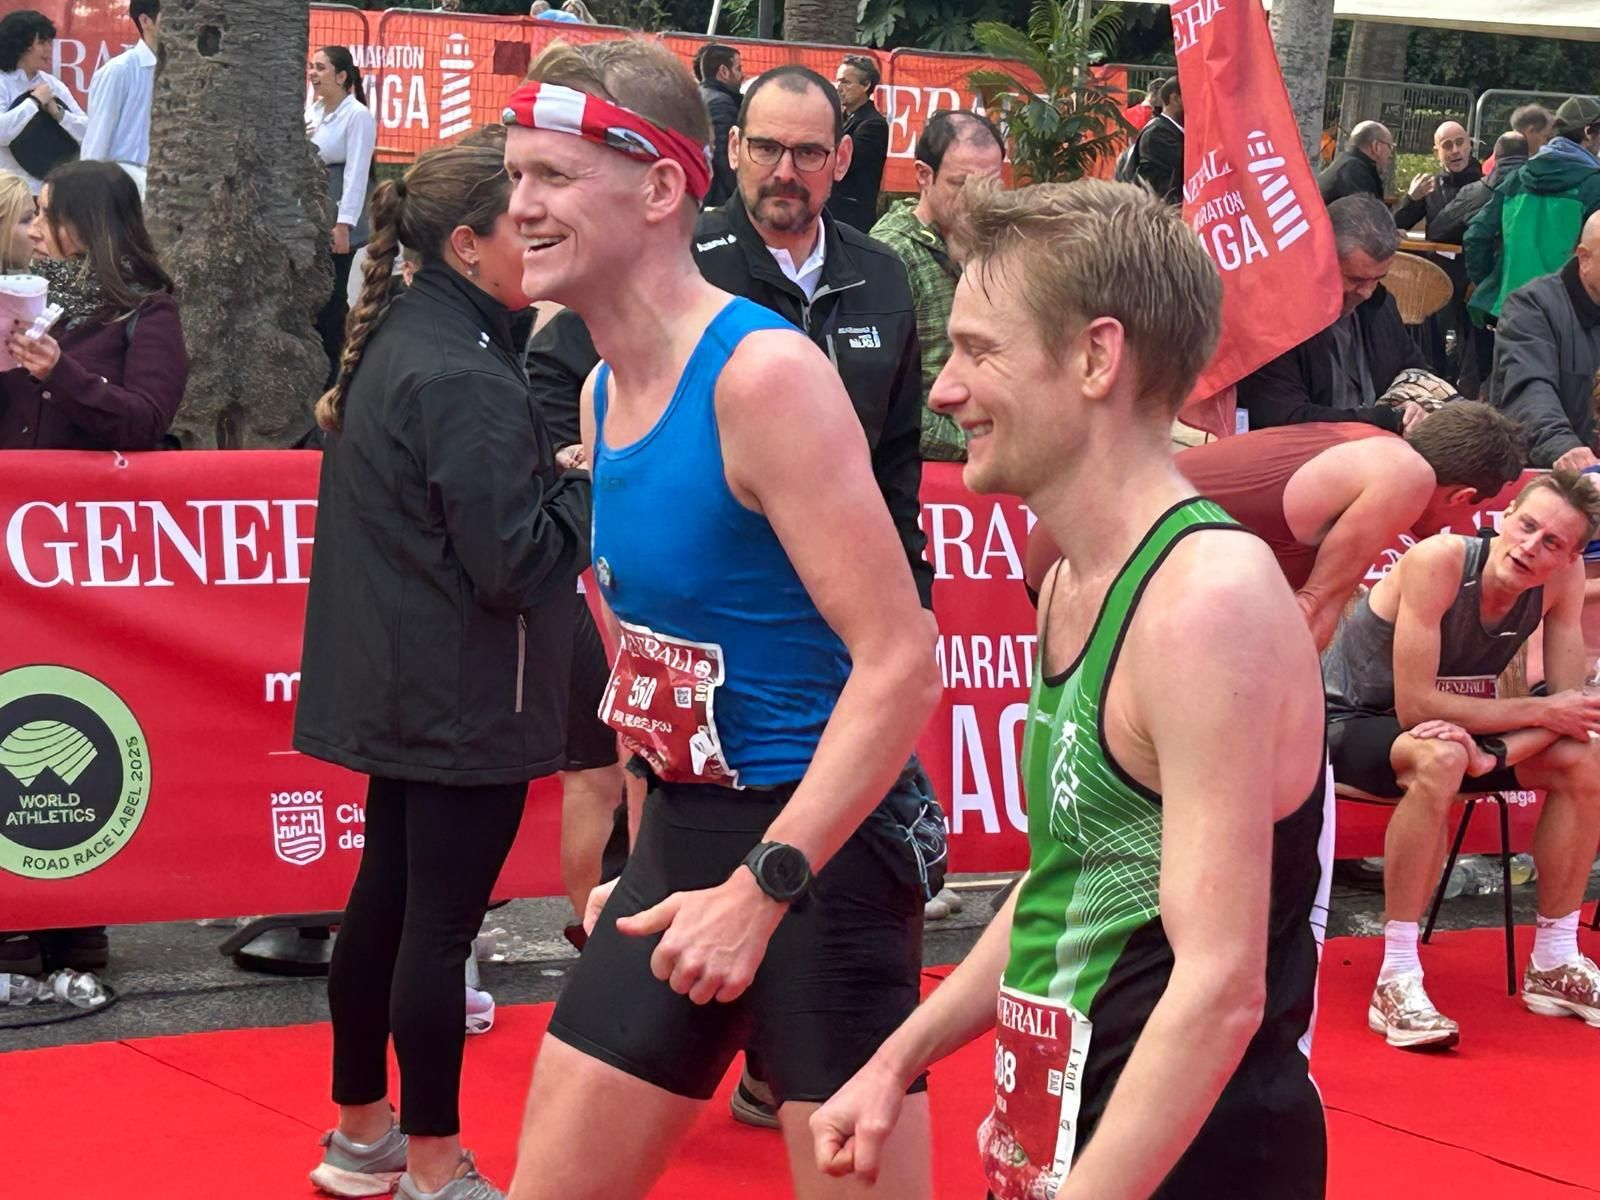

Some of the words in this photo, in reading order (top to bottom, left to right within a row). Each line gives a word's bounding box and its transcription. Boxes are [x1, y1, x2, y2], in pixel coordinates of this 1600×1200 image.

[125, 735, 144, 782] 2025
[6, 808, 96, 827] ATHLETICS
[19, 793, 81, 809] WORLD
[110, 786, 143, 838] LABEL
[22, 854, 70, 871] ROAD
[73, 833, 116, 867] RACE
[999, 999, 1060, 1041] ERALI
